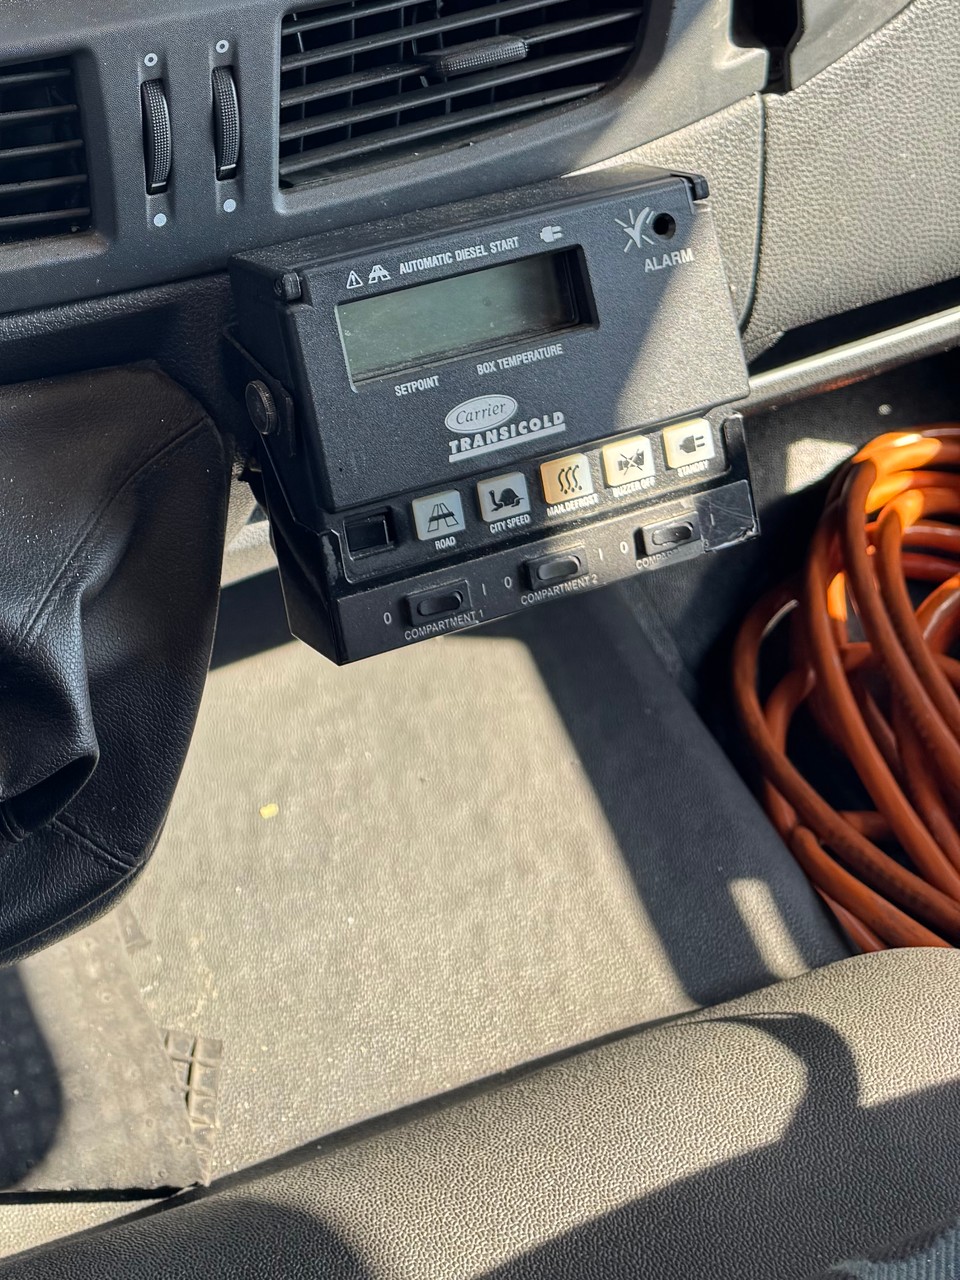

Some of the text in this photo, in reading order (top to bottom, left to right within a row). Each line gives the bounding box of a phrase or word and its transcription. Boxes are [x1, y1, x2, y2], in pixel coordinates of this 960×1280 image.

[399, 236, 519, 276] AUTOMATIC DIESEL START
[644, 247, 694, 274] ALARM
[476, 343, 563, 376] BOX TEMPERATURE
[394, 375, 440, 397] SETPOINT
[455, 401, 507, 424] Carrier
[448, 411, 565, 453] TRANSICOLD
[677, 460, 709, 477] STANDBY
[612, 478, 641, 498] BUZZER
[489, 514, 531, 534] CITY SPEED
[435, 535, 456, 550] ROAD
[520, 577, 592, 605] COMPARTMENT
[404, 611, 477, 641] COMPARTMENT
